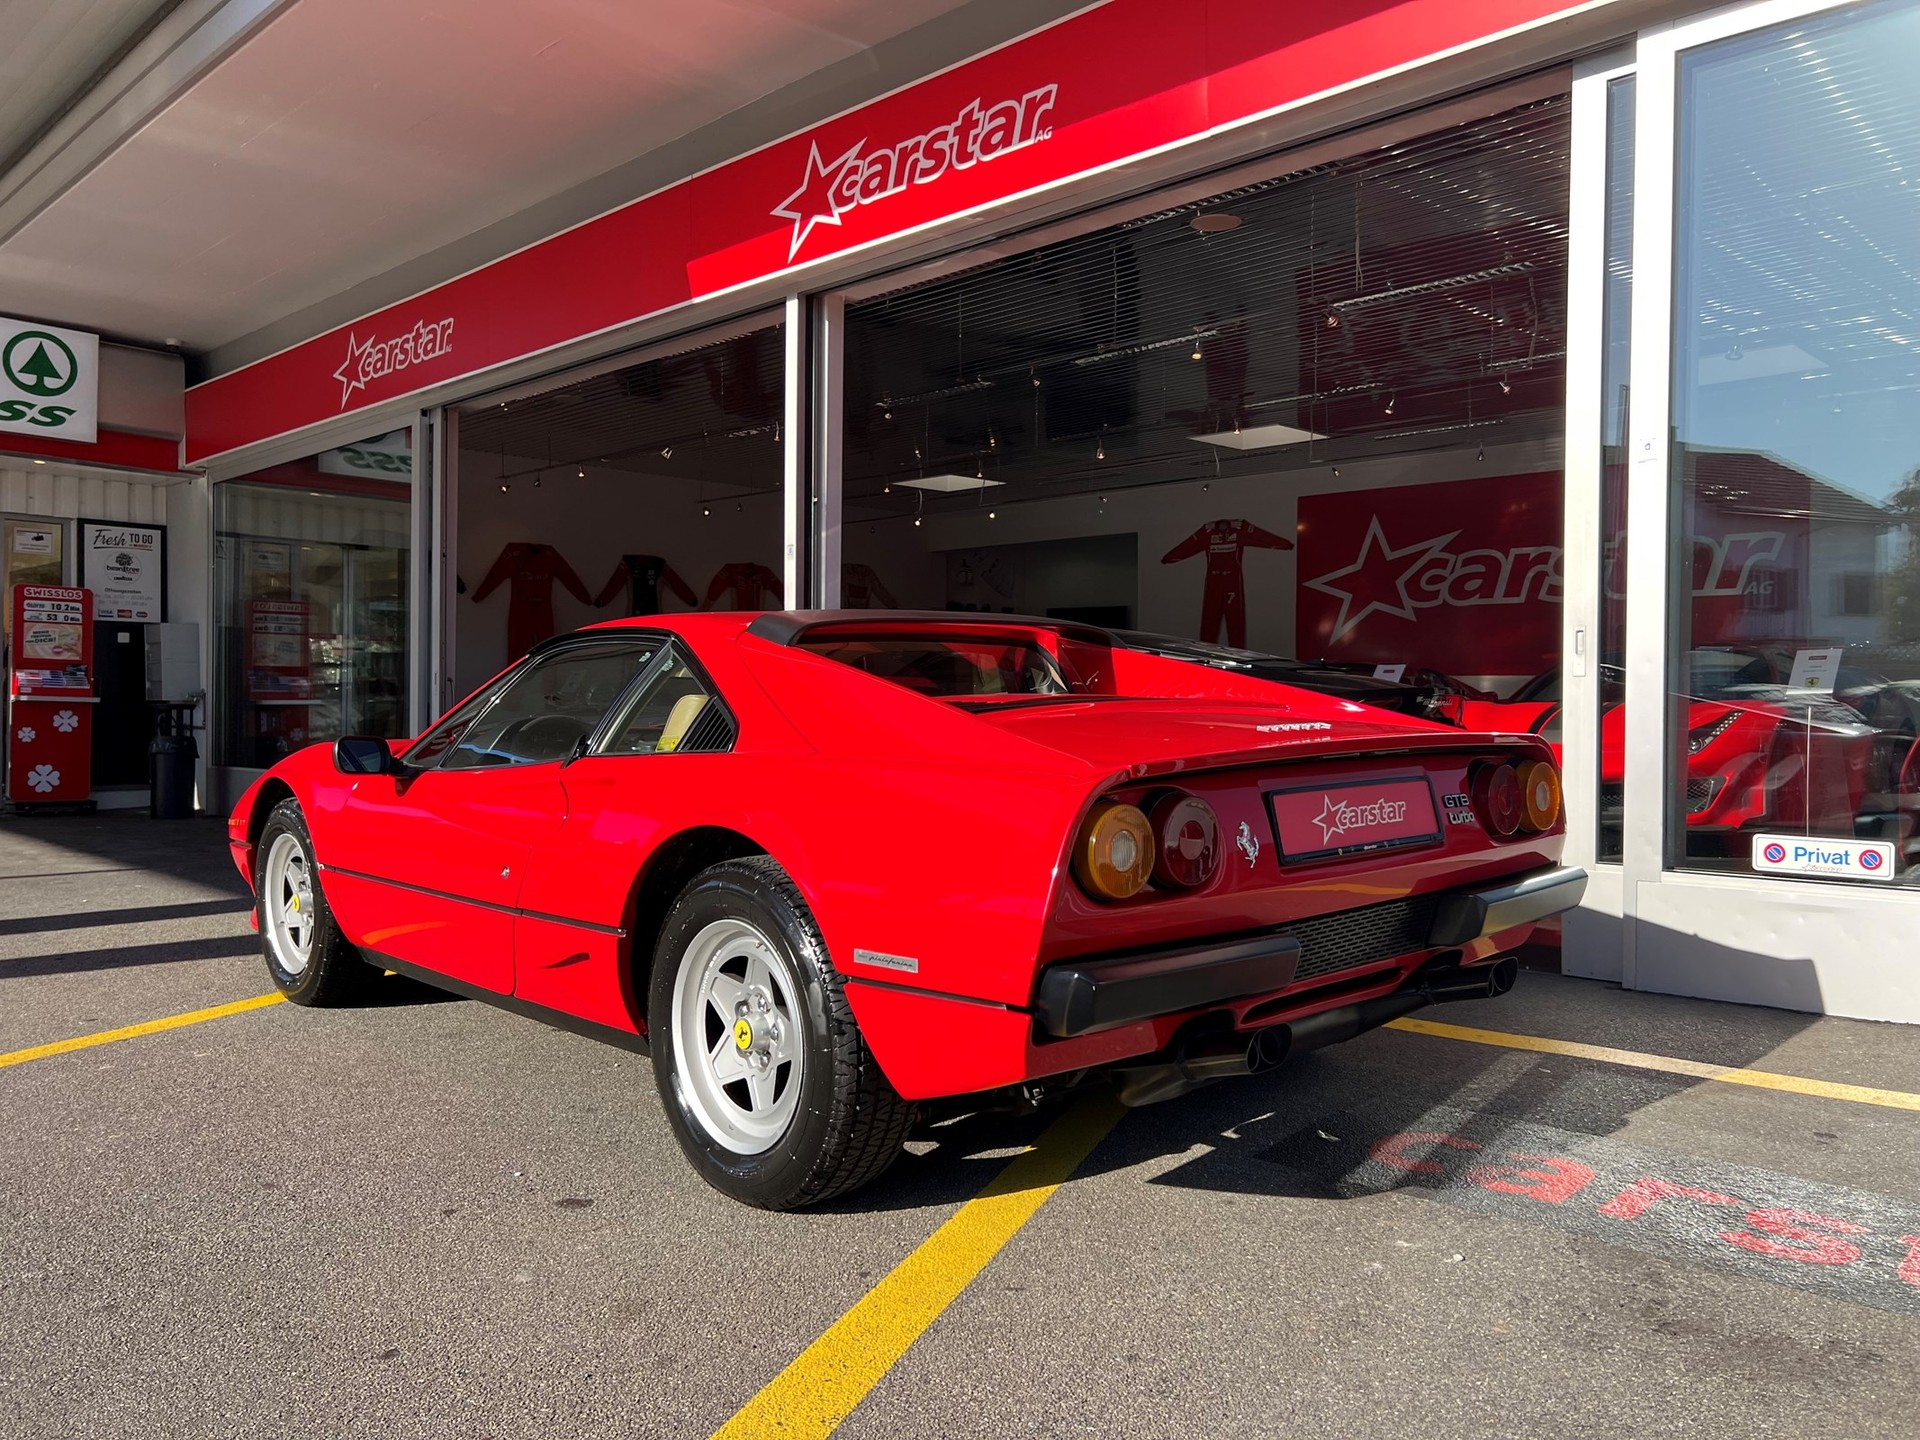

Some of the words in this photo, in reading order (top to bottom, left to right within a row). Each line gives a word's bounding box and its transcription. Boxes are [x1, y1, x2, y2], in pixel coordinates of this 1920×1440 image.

[827, 84, 1058, 213] carstar
[1034, 126, 1053, 143] AG
[358, 318, 454, 382] carstar
[93, 529, 127, 546] Fresh
[129, 533, 140, 543] TO
[142, 534, 153, 545] GO
[25, 588, 82, 599] SWISSLOS
[1747, 580, 1775, 595] AG
[1443, 793, 1470, 808] GTB
[1336, 798, 1406, 829] carstar
[1449, 811, 1475, 825] turbo
[1794, 846, 1851, 866] Privat
